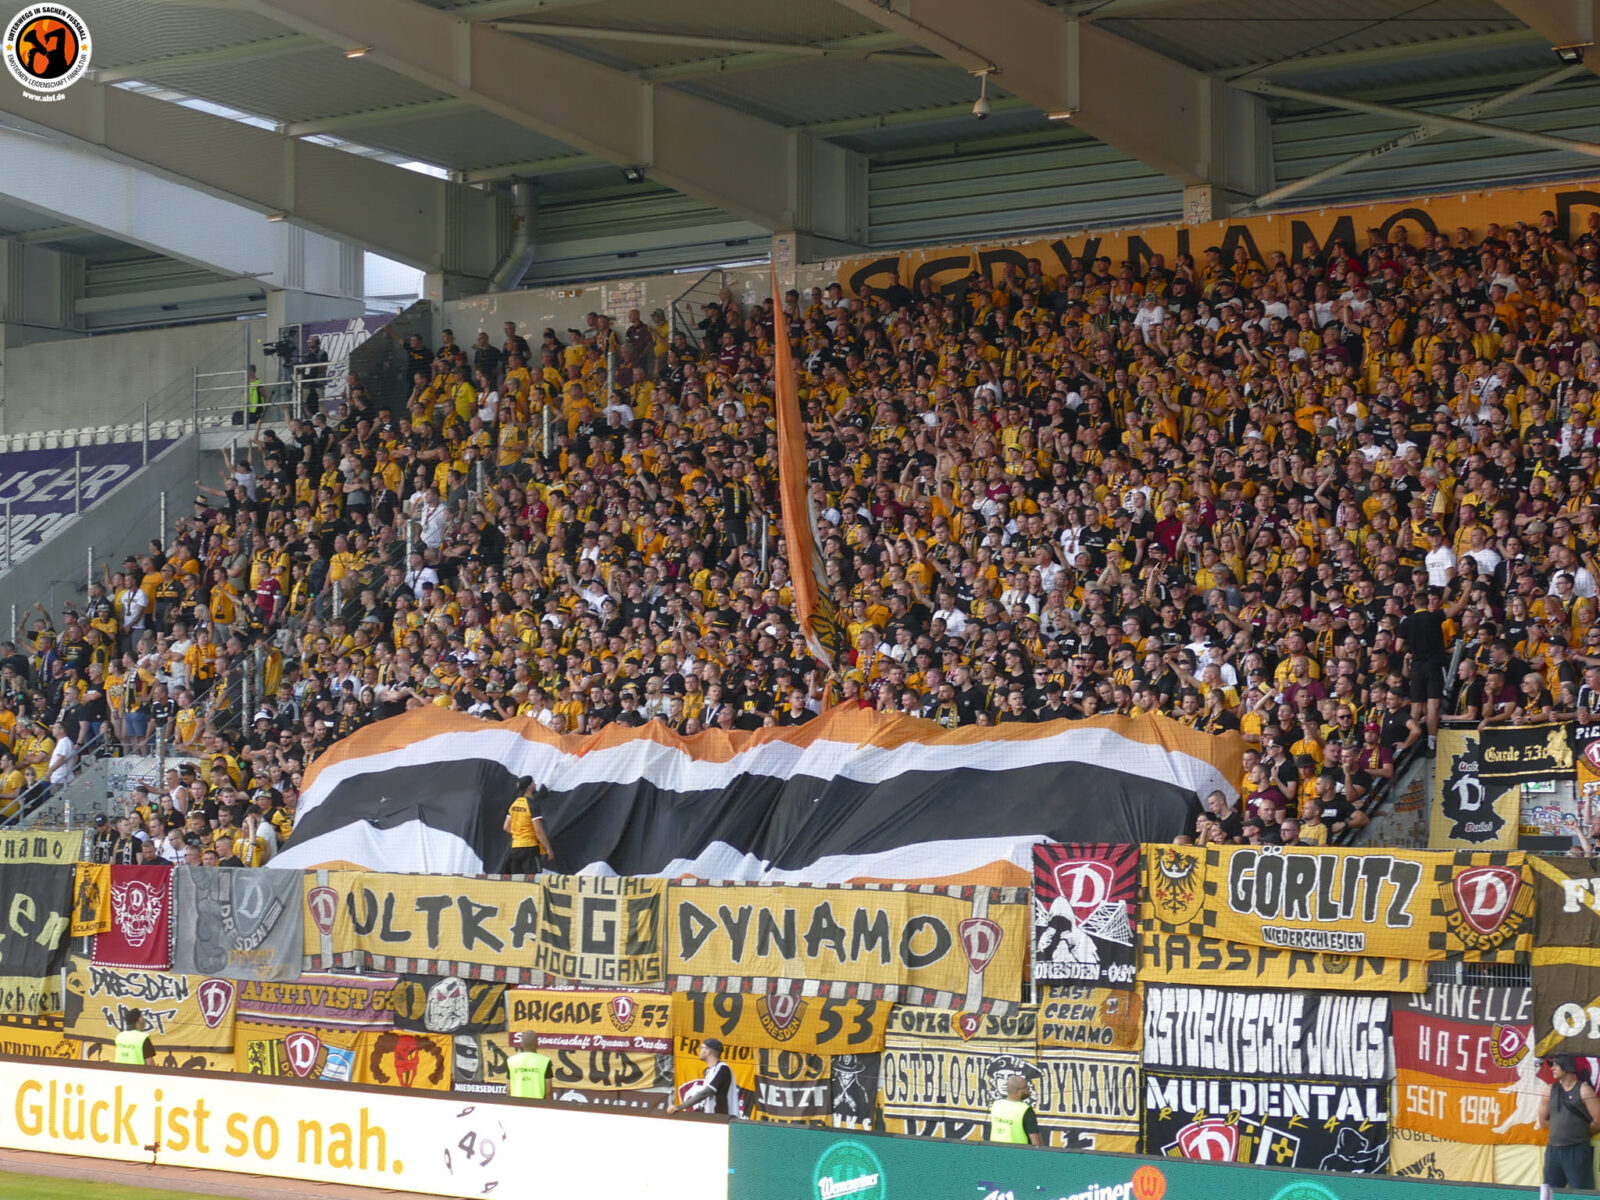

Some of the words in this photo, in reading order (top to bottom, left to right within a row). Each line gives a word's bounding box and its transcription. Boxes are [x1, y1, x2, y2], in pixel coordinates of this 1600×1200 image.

[1227, 845, 1424, 928] GÖRLITZ
[220, 904, 268, 951] DRESDEN
[678, 900, 953, 969] DYNAMO
[1262, 926, 1364, 951] NIEDERSCHLESIEN
[1447, 913, 1523, 951] DRESDEN
[535, 943, 660, 981] HOOLIGANS
[1035, 962, 1100, 981] DRESDEN
[88, 966, 191, 1003] DRESDEN
[240, 980, 368, 1010] AKTIVIST
[513, 999, 603, 1025] BRIGADE
[640, 1004, 669, 1029] 53
[686, 992, 745, 1037] 19
[815, 998, 887, 1046] 53
[759, 1013, 801, 1042] DRESDEN
[1044, 1002, 1097, 1022] CREW
[1041, 1023, 1115, 1046] DYNAMO
[1144, 987, 1304, 1075] OSTDEUTSCHE
[1307, 995, 1389, 1080] JUNGS
[1418, 1024, 1491, 1075] HASE
[758, 1047, 824, 1081] LOS
[454, 1083, 507, 1094] NIEDERSEDLITZ
[758, 1083, 828, 1108] JETZT
[884, 1052, 991, 1108] OSTBLOCK
[1039, 1061, 1138, 1118] DYNAMO
[1147, 1076, 1389, 1122] MULDENTAL
[1406, 1085, 1448, 1121] SEIT
[1458, 1094, 1501, 1126] 1984
[15, 1079, 138, 1146] Glück
[154, 1088, 210, 1154] ist
[224, 1111, 279, 1160] so
[297, 1107, 404, 1175] nah.
